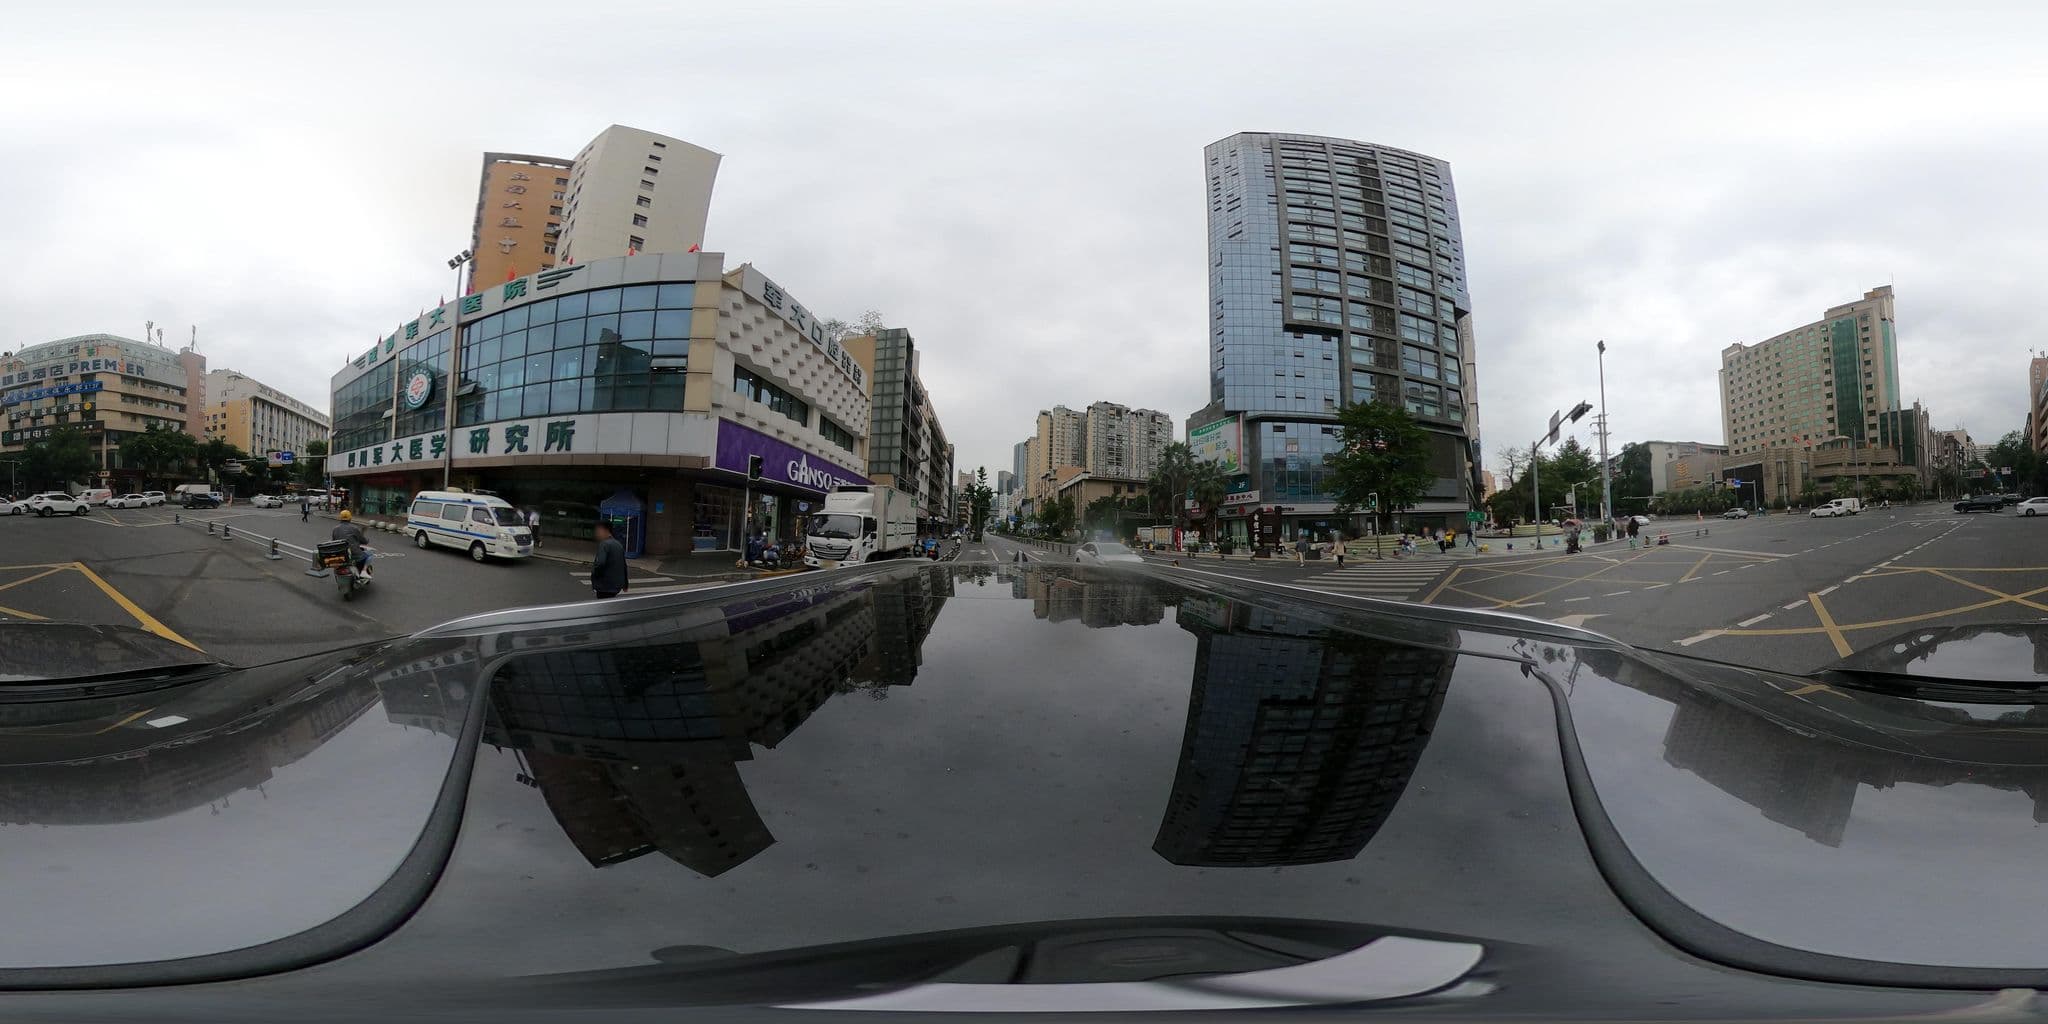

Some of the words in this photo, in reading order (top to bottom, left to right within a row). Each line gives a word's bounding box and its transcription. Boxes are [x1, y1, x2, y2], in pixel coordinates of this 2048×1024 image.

[69, 358, 145, 377] PREMIER
[347, 420, 576, 468] 四川军大医学研究所
[787, 455, 832, 490] GANSO
